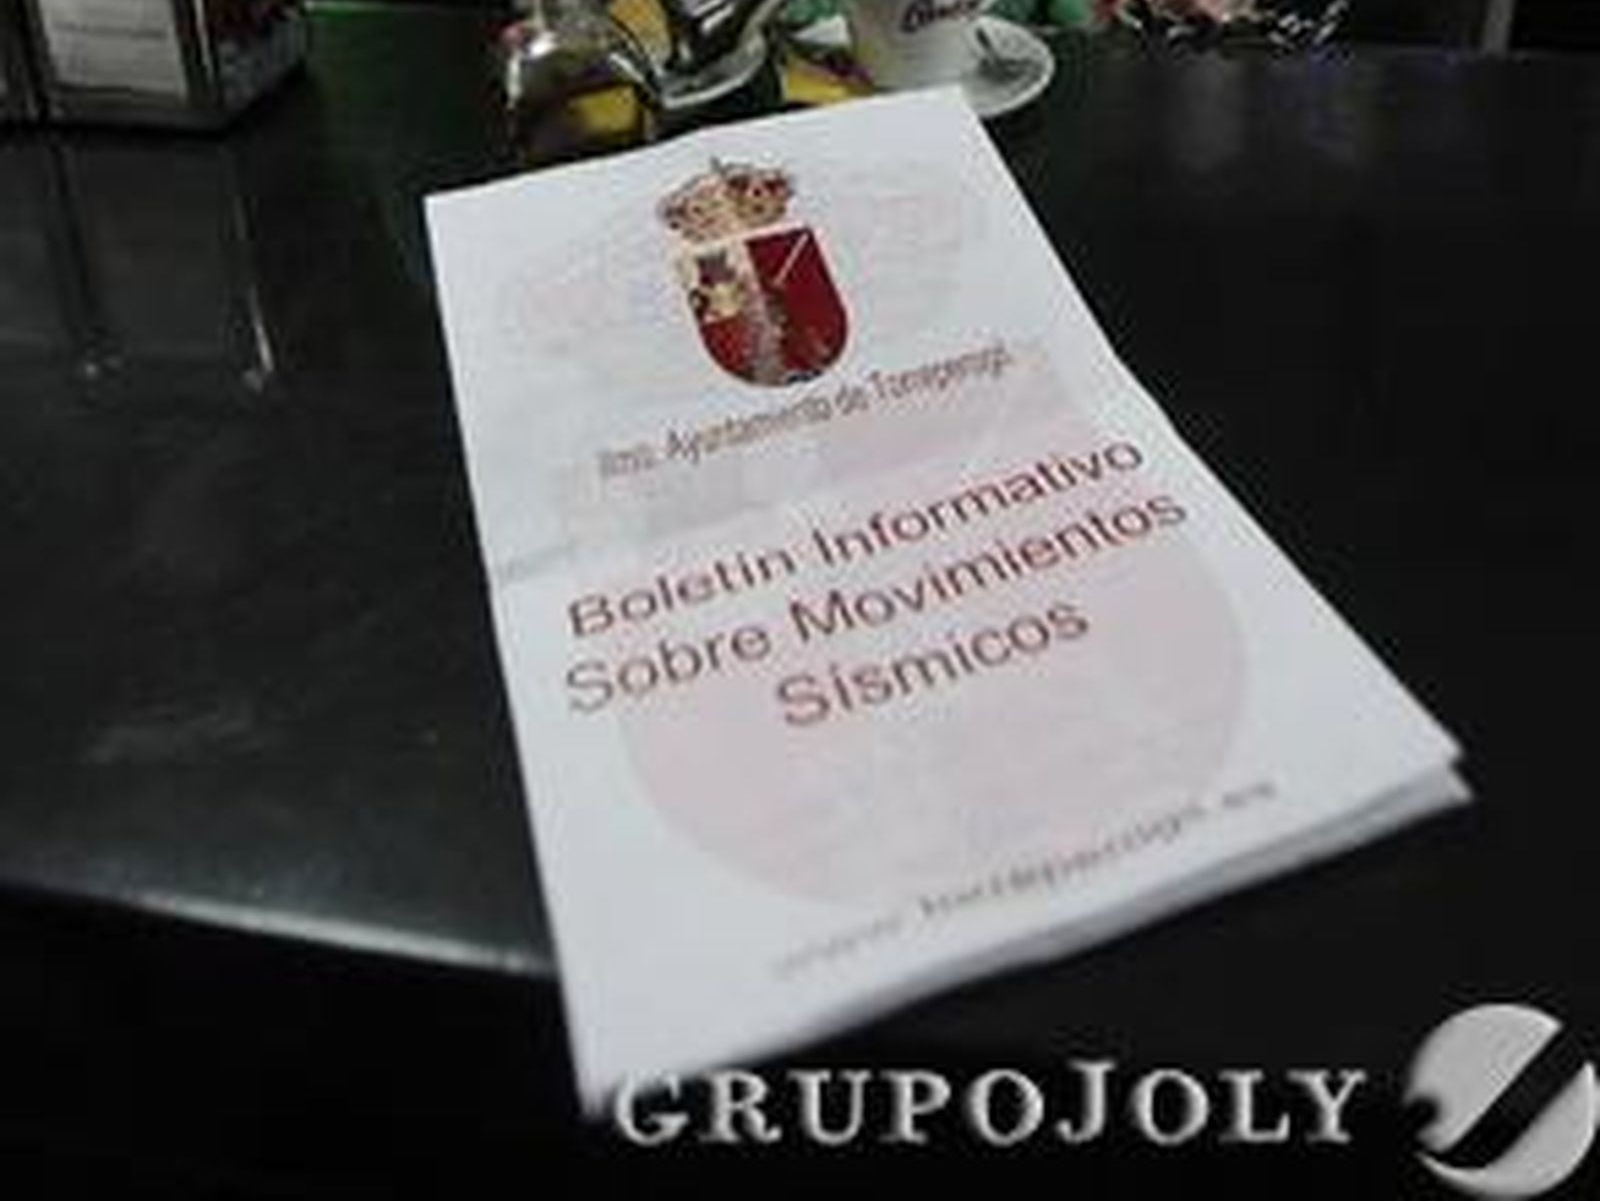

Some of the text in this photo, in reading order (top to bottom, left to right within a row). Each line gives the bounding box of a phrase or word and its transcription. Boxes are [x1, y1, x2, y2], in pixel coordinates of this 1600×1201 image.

[812, 439, 1144, 568] Informativo
[564, 492, 1190, 713] Sobre Movimientos
